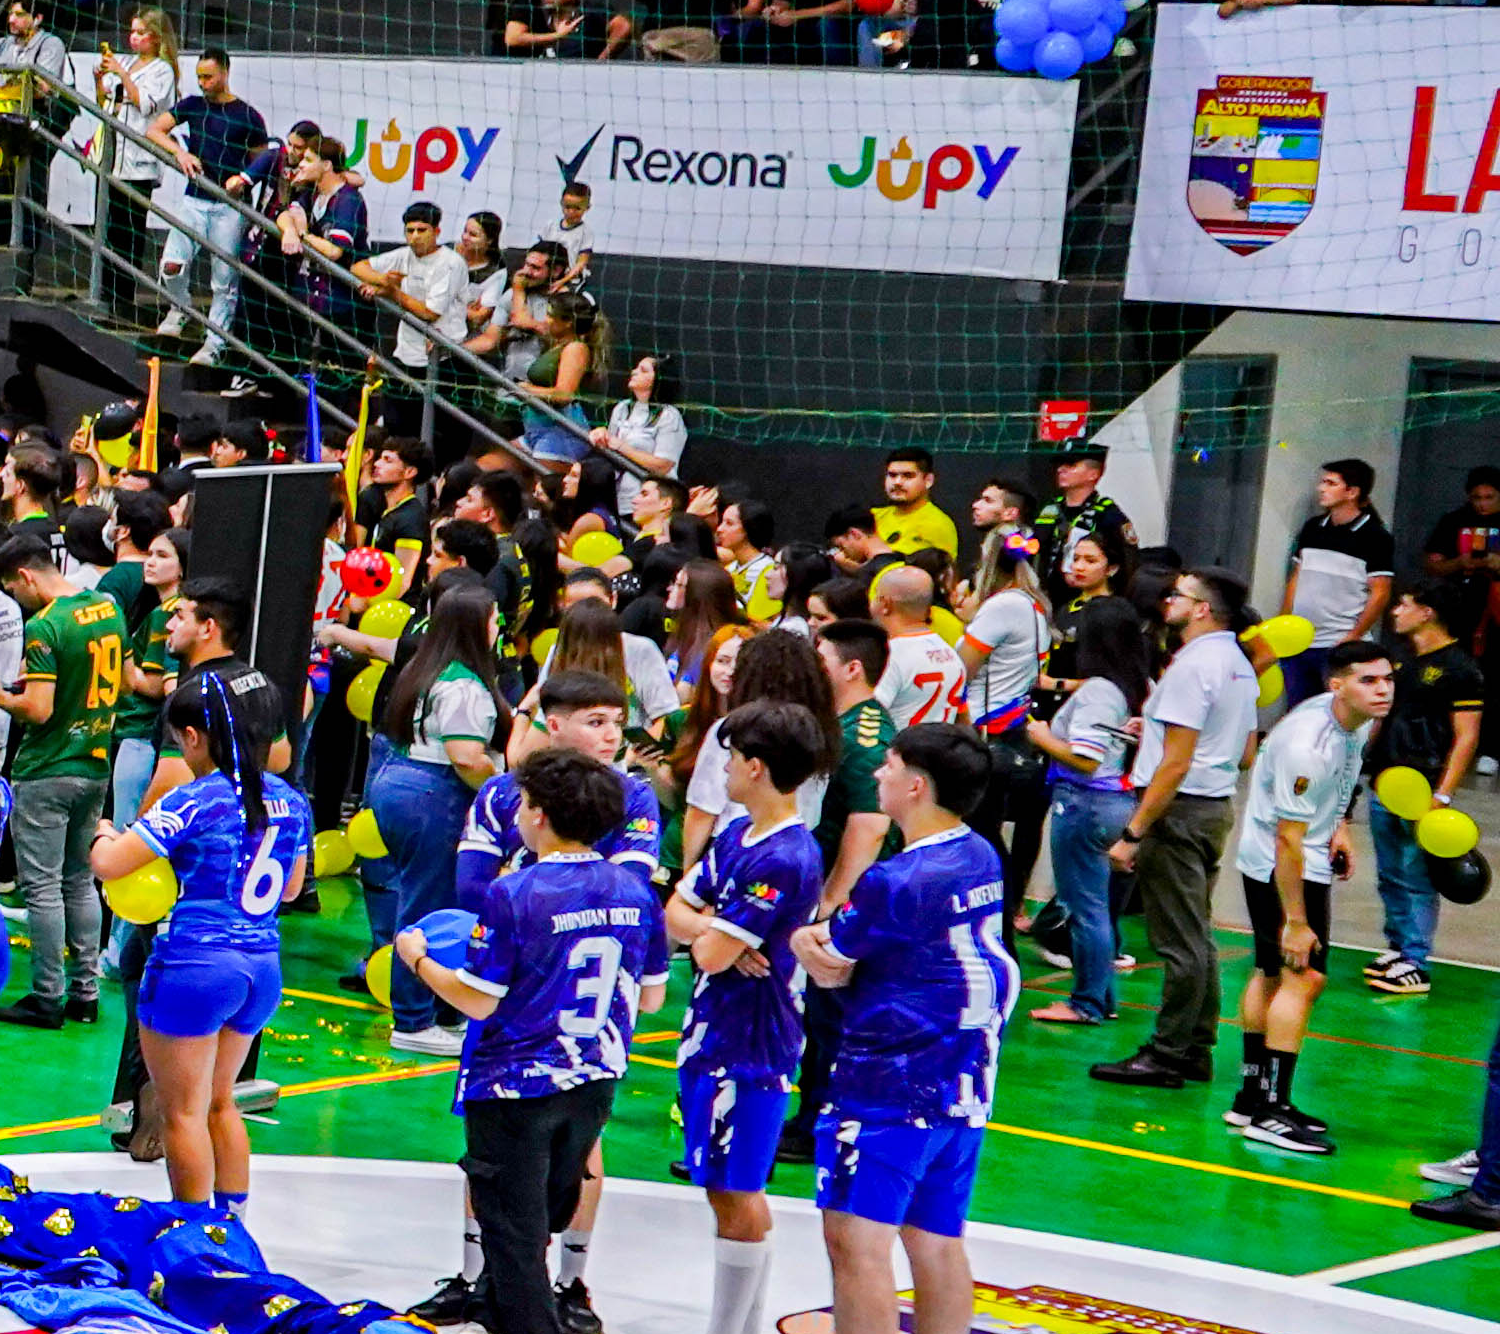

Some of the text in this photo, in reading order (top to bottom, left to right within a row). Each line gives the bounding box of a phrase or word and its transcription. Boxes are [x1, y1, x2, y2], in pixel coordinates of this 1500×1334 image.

[1202, 98, 1322, 118] ALTO PARANÁ
[611, 133, 785, 189] Rexona
[87, 634, 122, 709] 19
[241, 825, 284, 916] 6
[610, 908, 641, 926] ORTIZ
[558, 936, 623, 1038] 3
